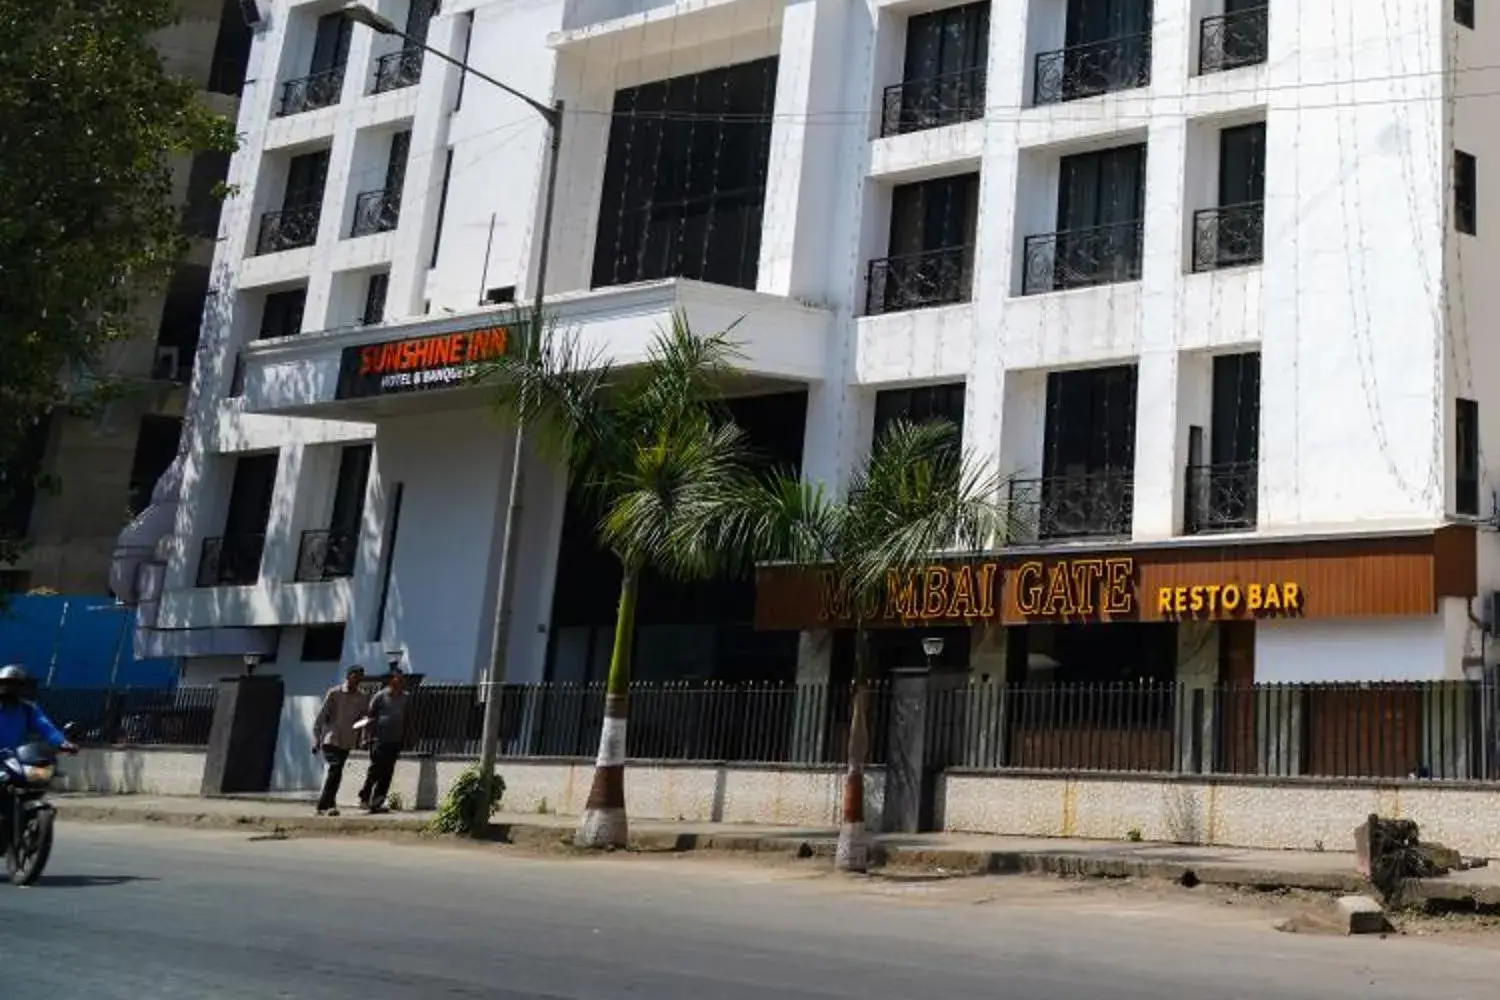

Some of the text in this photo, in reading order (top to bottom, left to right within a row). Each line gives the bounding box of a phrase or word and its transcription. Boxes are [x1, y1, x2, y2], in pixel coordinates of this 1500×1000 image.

[357, 327, 509, 376] SUNSHINE INN
[381, 372, 412, 389] HOTEL
[1016, 557, 1134, 616] GATE
[1159, 583, 1240, 613] RESTO
[1246, 581, 1299, 610] BAR
